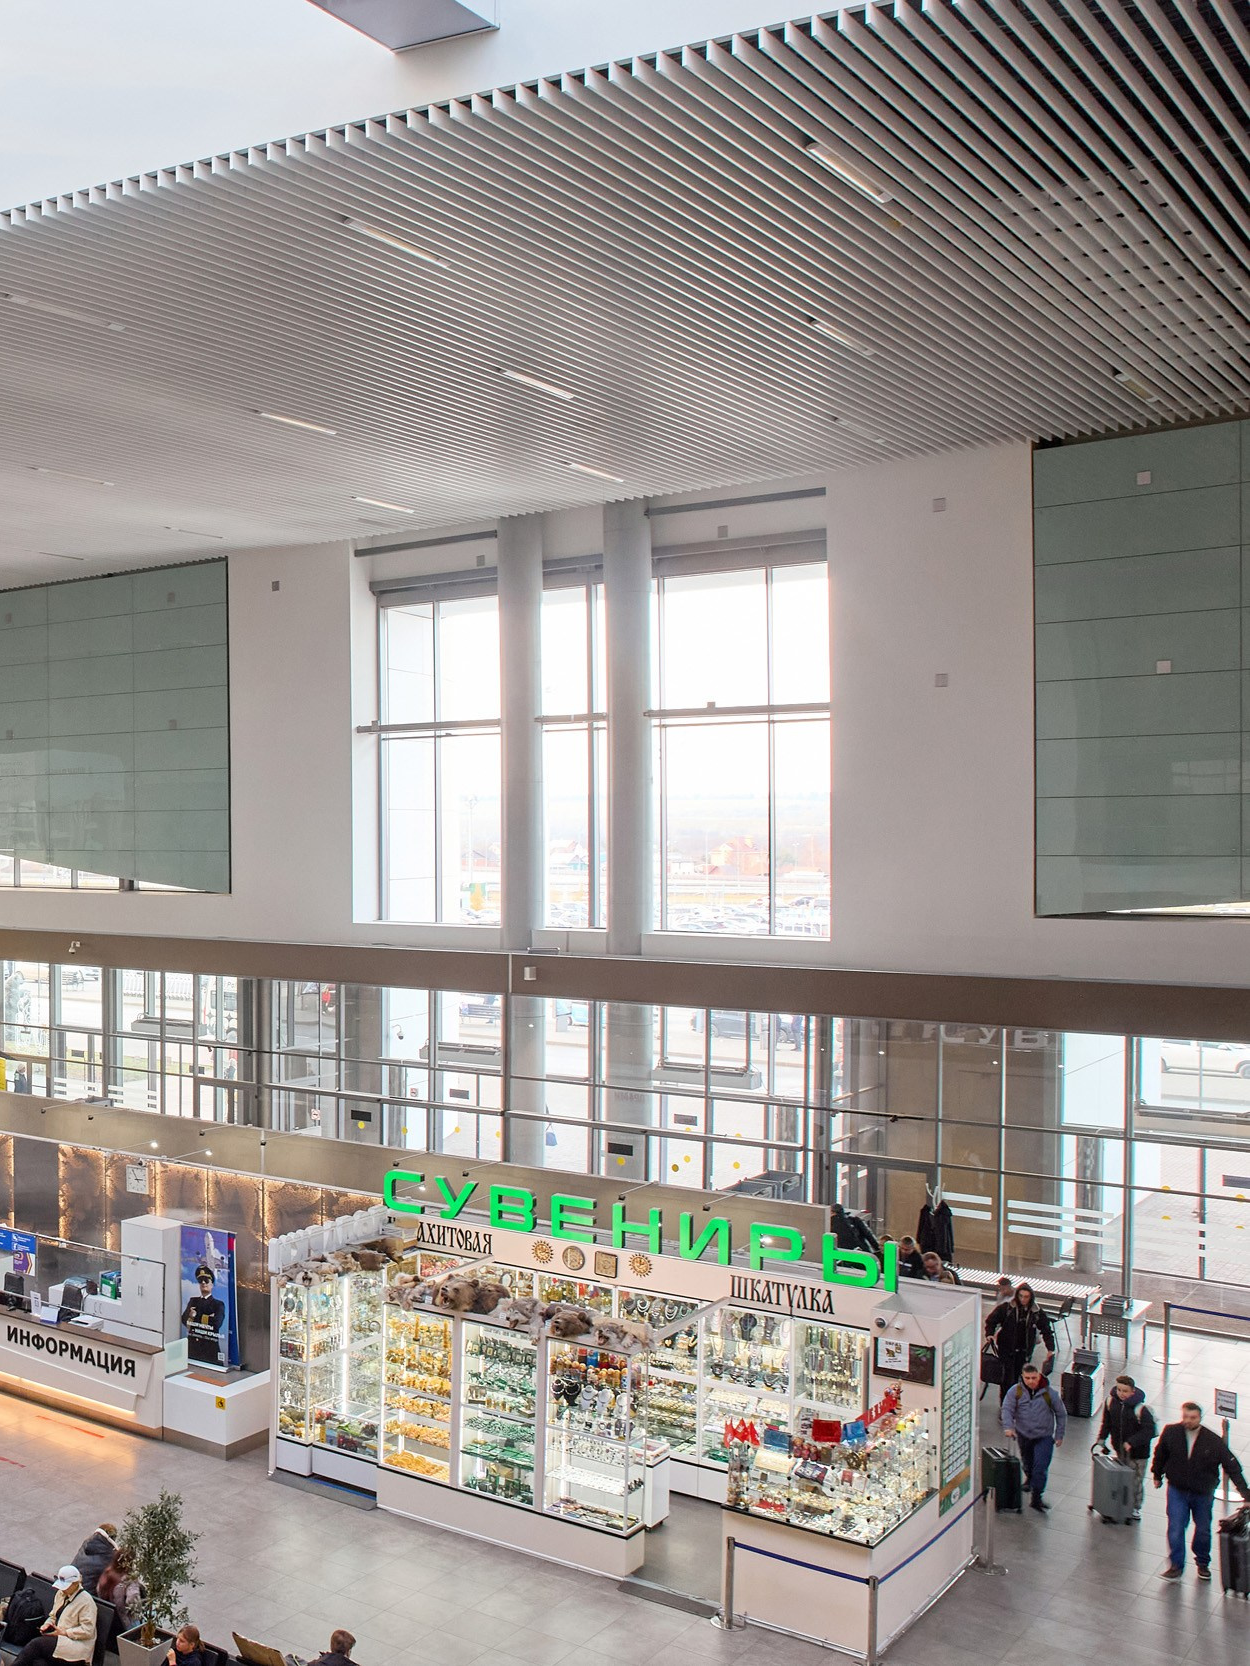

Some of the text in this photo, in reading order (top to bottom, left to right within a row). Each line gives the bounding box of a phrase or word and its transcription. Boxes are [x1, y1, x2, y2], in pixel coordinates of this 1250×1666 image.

[383, 1168, 900, 1292] СУВЕНИРЫ
[388, 1216, 493, 1255] АХИТОВАЯ
[729, 1273, 836, 1315] ШКАТУЛКА
[6, 1325, 137, 1378] ИНФОРМАЦИЯ
